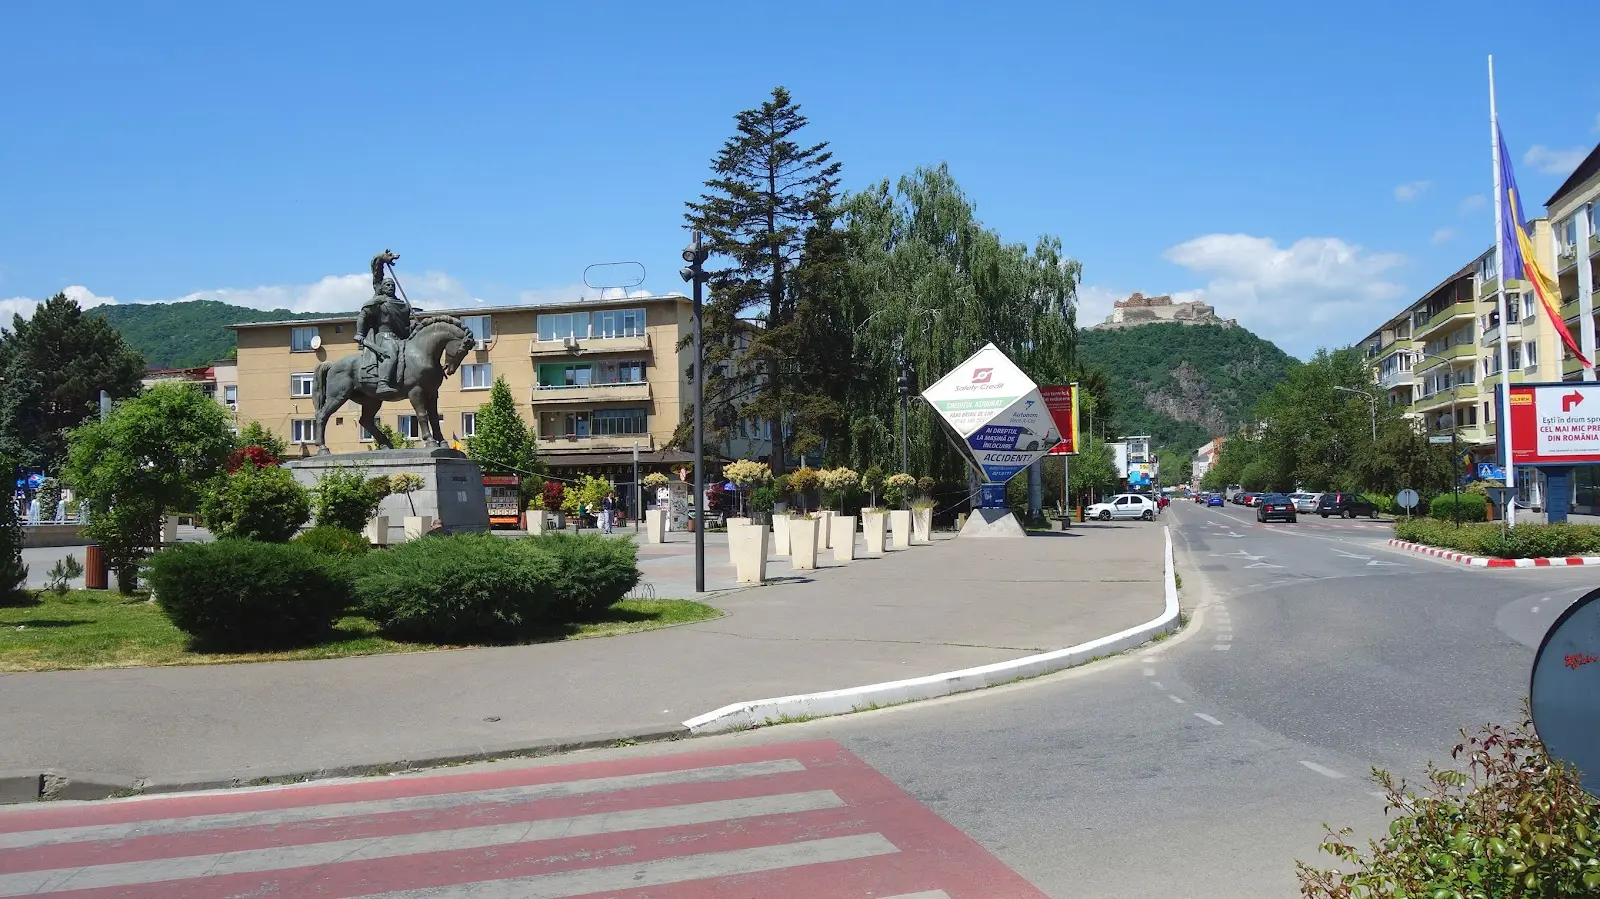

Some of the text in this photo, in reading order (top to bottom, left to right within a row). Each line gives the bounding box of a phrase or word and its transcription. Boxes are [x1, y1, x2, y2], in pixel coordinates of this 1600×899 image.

[980, 382, 1004, 390] Credit
[1566, 416, 1586, 424] drum
[1555, 425, 1569, 433] MAI
[1548, 434, 1561, 442] DIN
[983, 453, 1033, 462] ACCIDENT?
